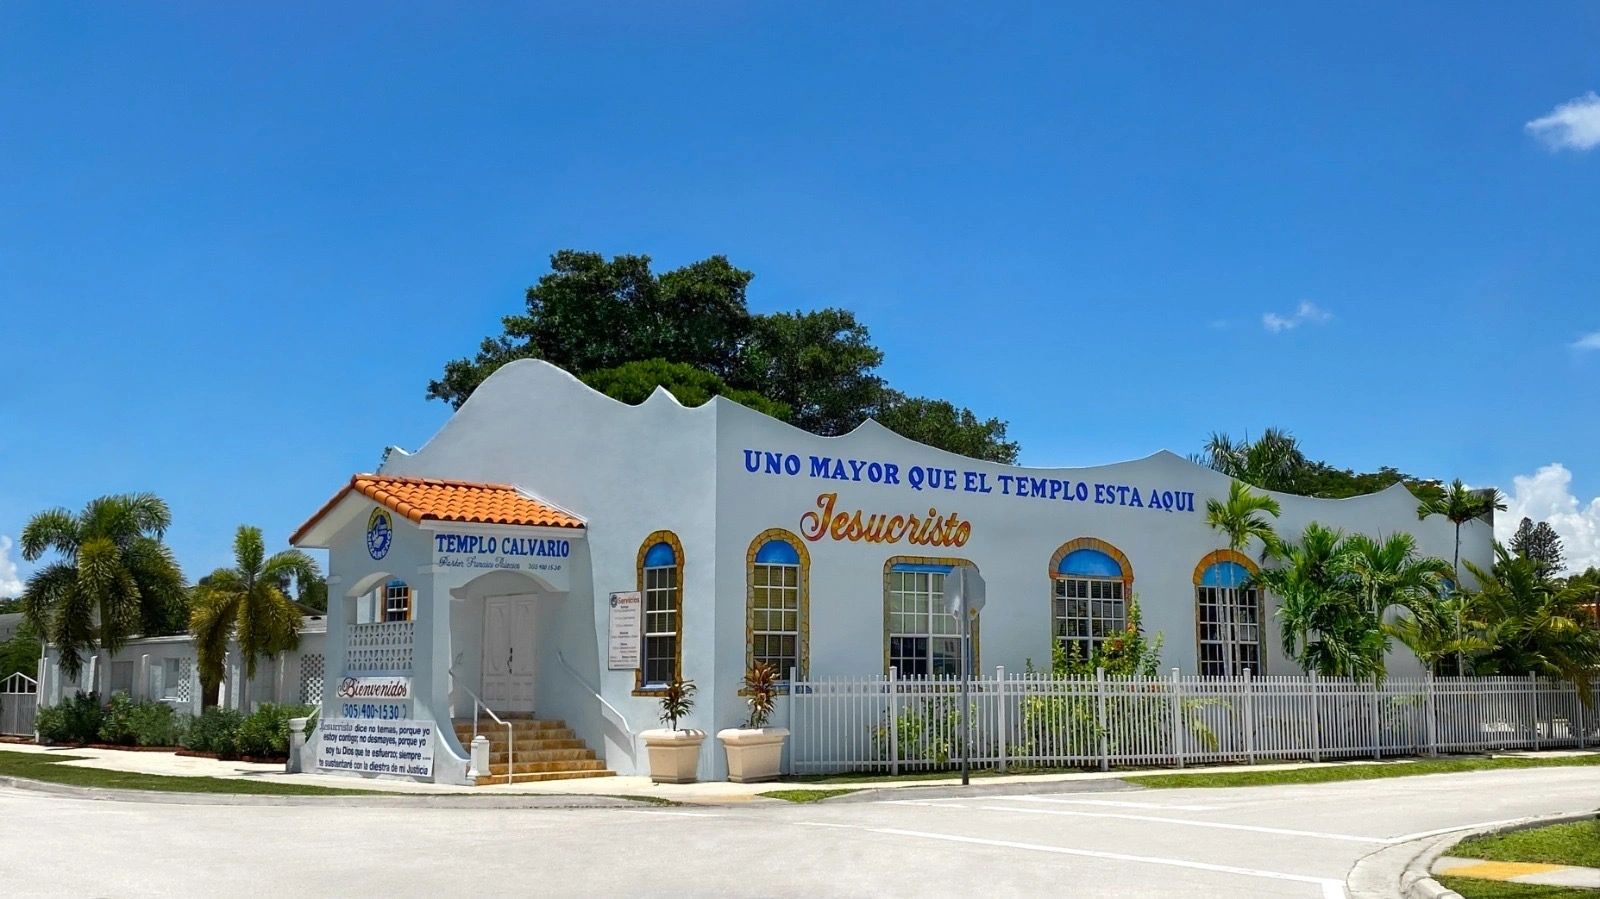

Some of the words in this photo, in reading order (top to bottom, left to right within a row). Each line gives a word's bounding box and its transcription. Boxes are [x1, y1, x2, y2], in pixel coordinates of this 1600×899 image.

[743, 449, 800, 476] UNO
[809, 456, 900, 485] MAYOR
[908, 466, 957, 491] QUE
[964, 471, 992, 493] EL
[998, 475, 1088, 502] TEMPLO
[1094, 483, 1144, 508] ESTA
[1148, 489, 1195, 513] AQUI
[800, 493, 972, 548] Jesucristo
[435, 534, 497, 554] TEMPLO
[501, 537, 569, 558] CALVARIO
[338, 677, 407, 698] Bienvenidos
[355, 725, 367, 733] dice
[399, 728, 421, 737] porque
[423, 729, 431, 737] yo
[323, 733, 337, 743] estoy
[359, 735, 366, 743] no
[398, 738, 418, 748] porque
[419, 738, 427, 748] yo
[326, 747, 334, 756] soy
[343, 746, 354, 755] Dios
[355, 749, 364, 758] que
[365, 748, 371, 756] te
[399, 750, 422, 760] siempre
[364, 761, 369, 770] la
[369, 761, 390, 772] diestra
[391, 763, 398, 772] de
[399, 763, 406, 773] mi
[407, 764, 429, 776] Justicia
